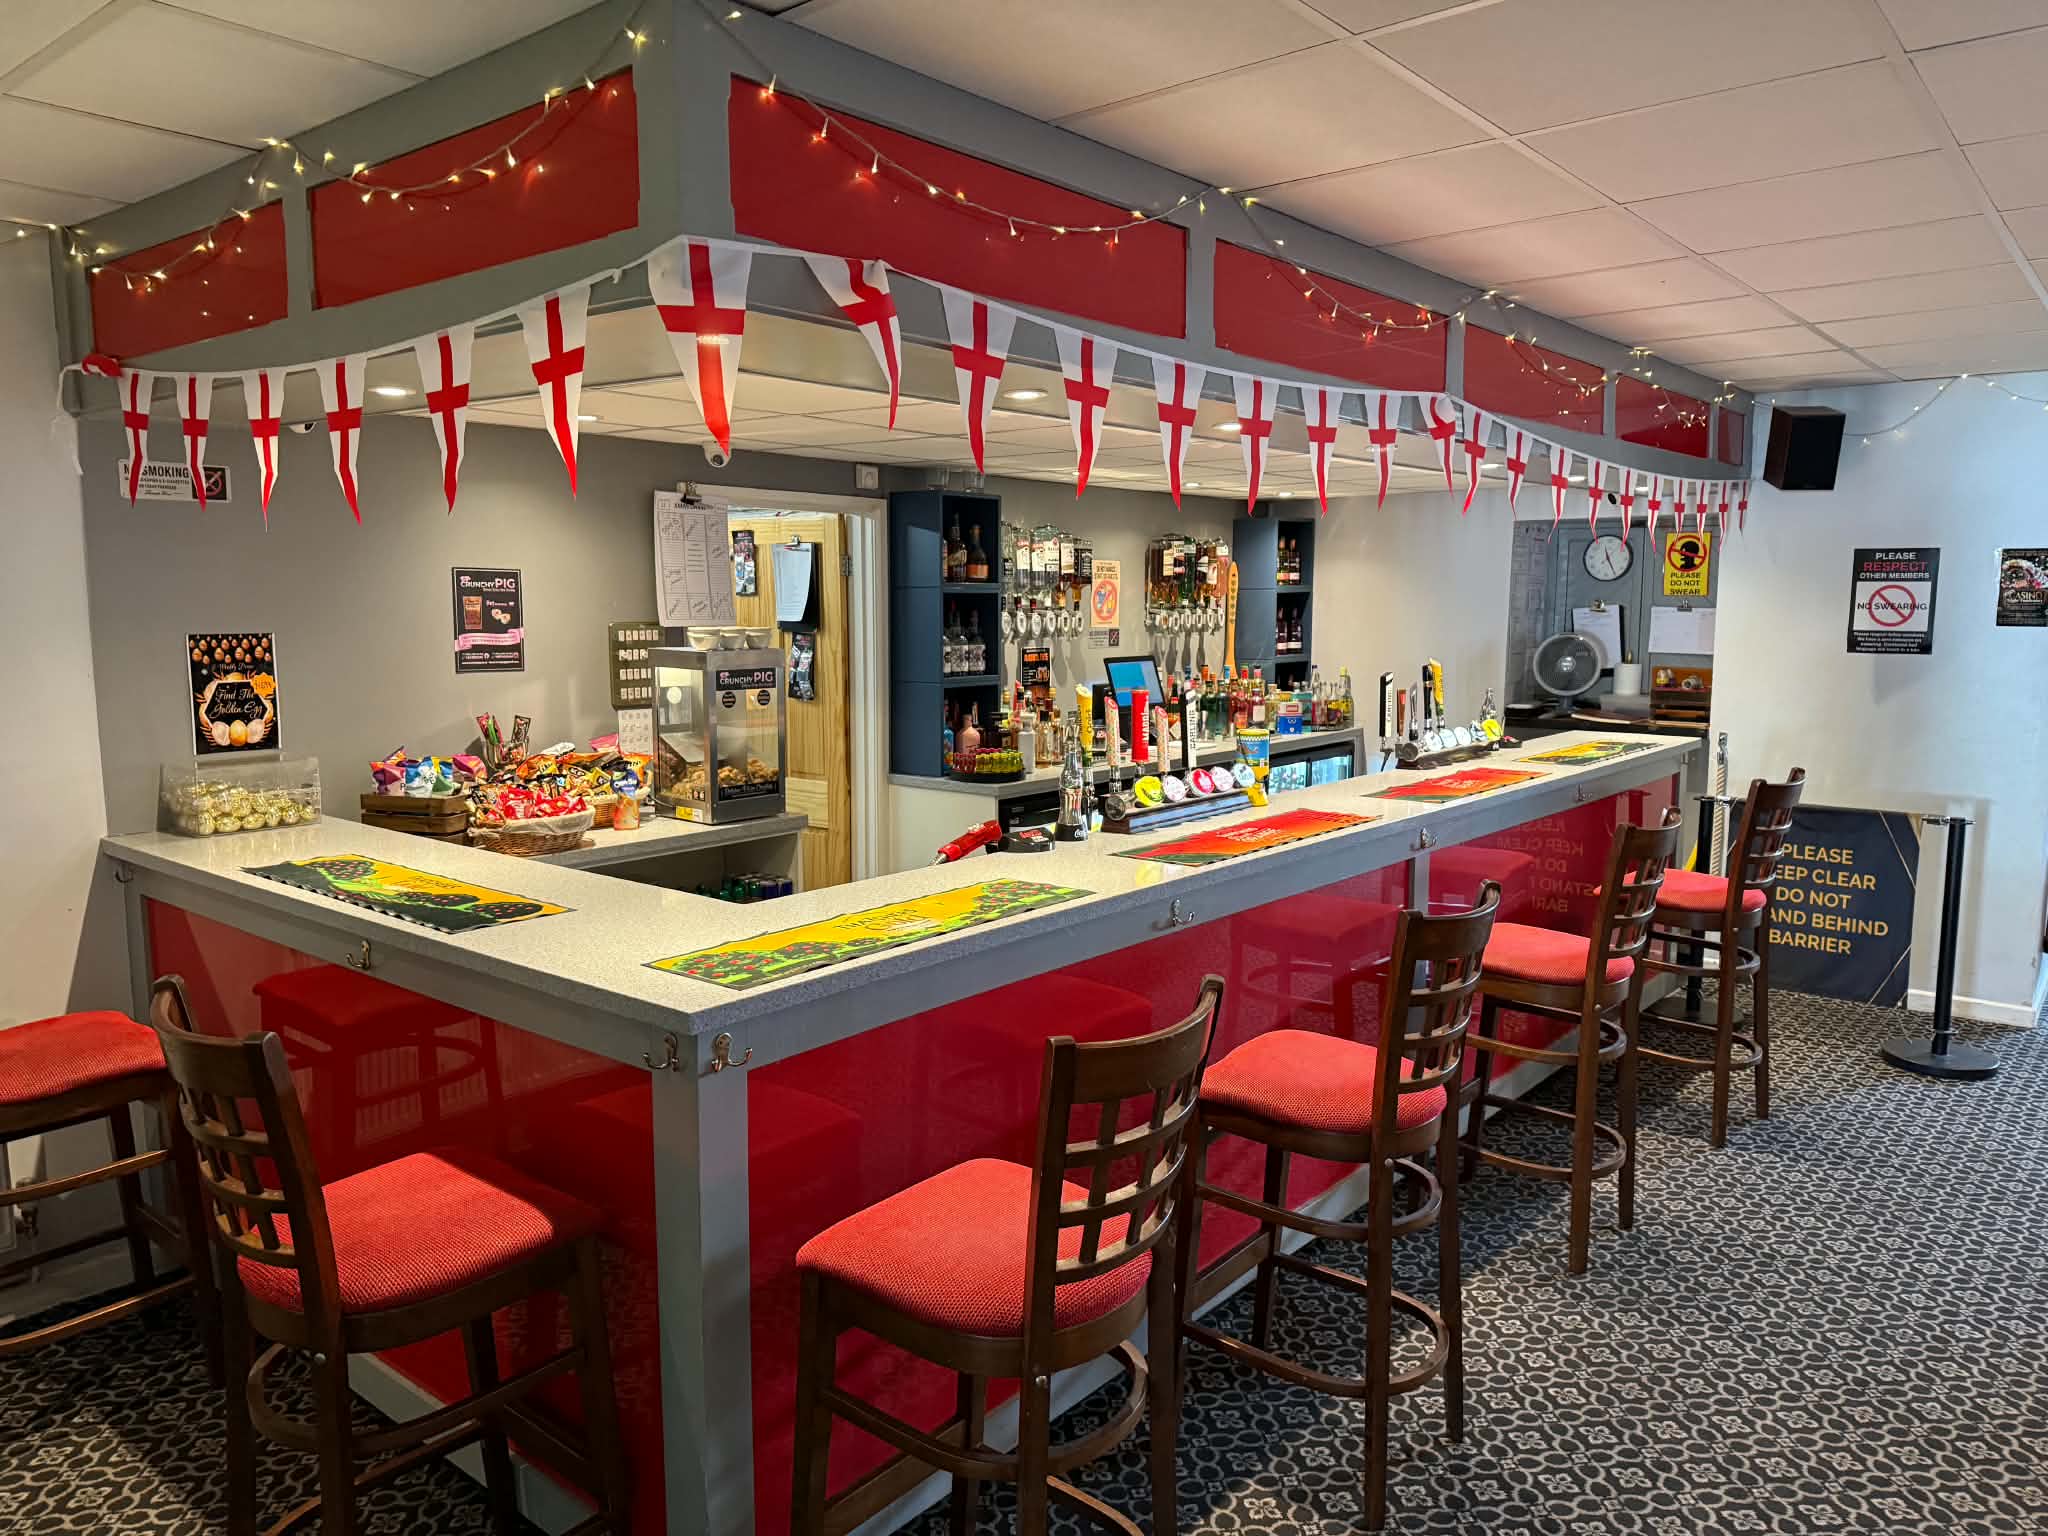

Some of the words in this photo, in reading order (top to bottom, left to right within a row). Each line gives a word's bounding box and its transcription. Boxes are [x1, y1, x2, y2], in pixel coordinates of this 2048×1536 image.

[142, 465, 189, 478] SMOKING
[1875, 552, 1917, 560] PLEASE
[1863, 561, 1928, 571] RESPECT
[495, 578, 516, 589] PIG
[1857, 602, 1872, 610] NO
[1873, 602, 1928, 610] SWEARING
[719, 676, 753, 685] CRUNCHY
[753, 671, 774, 683] PIG
[1782, 843, 1854, 865] PLEASE
[1776, 864, 1808, 881] EEP
[1812, 868, 1877, 891] CLEAR
[1775, 886, 1805, 903] DO
[1809, 889, 1852, 909] NOT
[1770, 907, 1807, 925] AND
[1811, 912, 1889, 936] BEHIND
[1769, 928, 1852, 955] BARRIER
